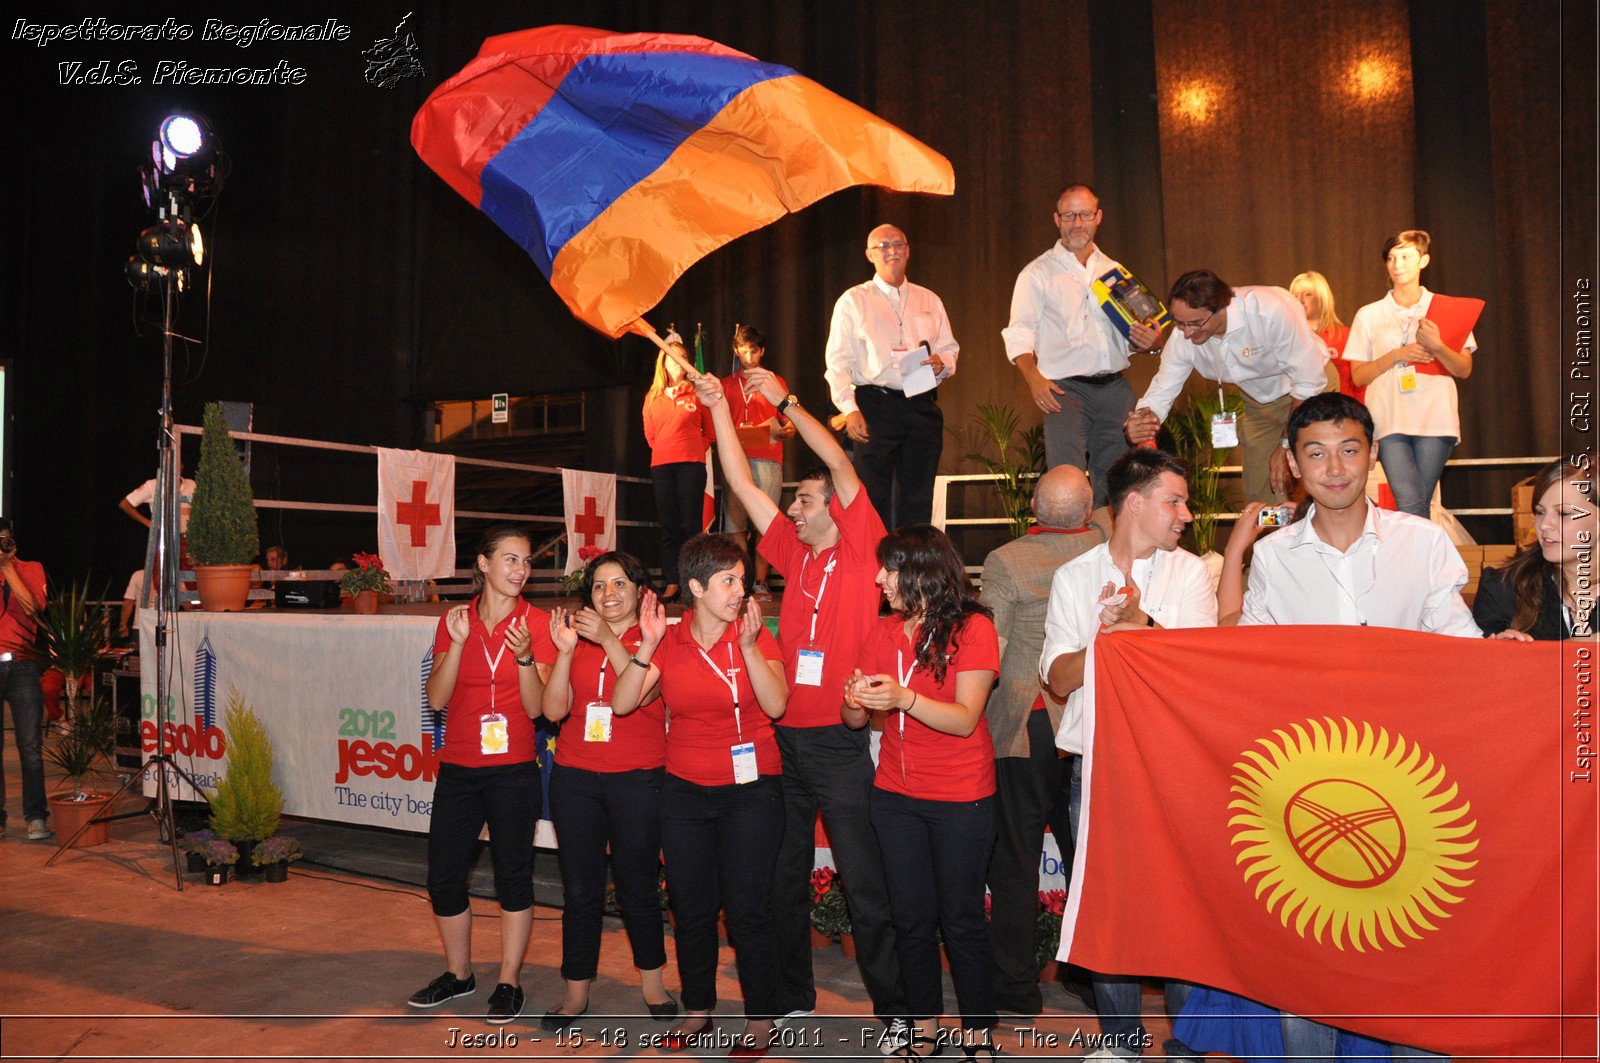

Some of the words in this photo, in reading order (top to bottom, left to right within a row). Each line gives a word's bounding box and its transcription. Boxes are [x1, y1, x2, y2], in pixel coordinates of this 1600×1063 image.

[141, 693, 176, 721] 02
[338, 707, 396, 739] 2012
[153, 767, 180, 788] cty
[335, 786, 367, 807] The
[370, 791, 402, 816] city
